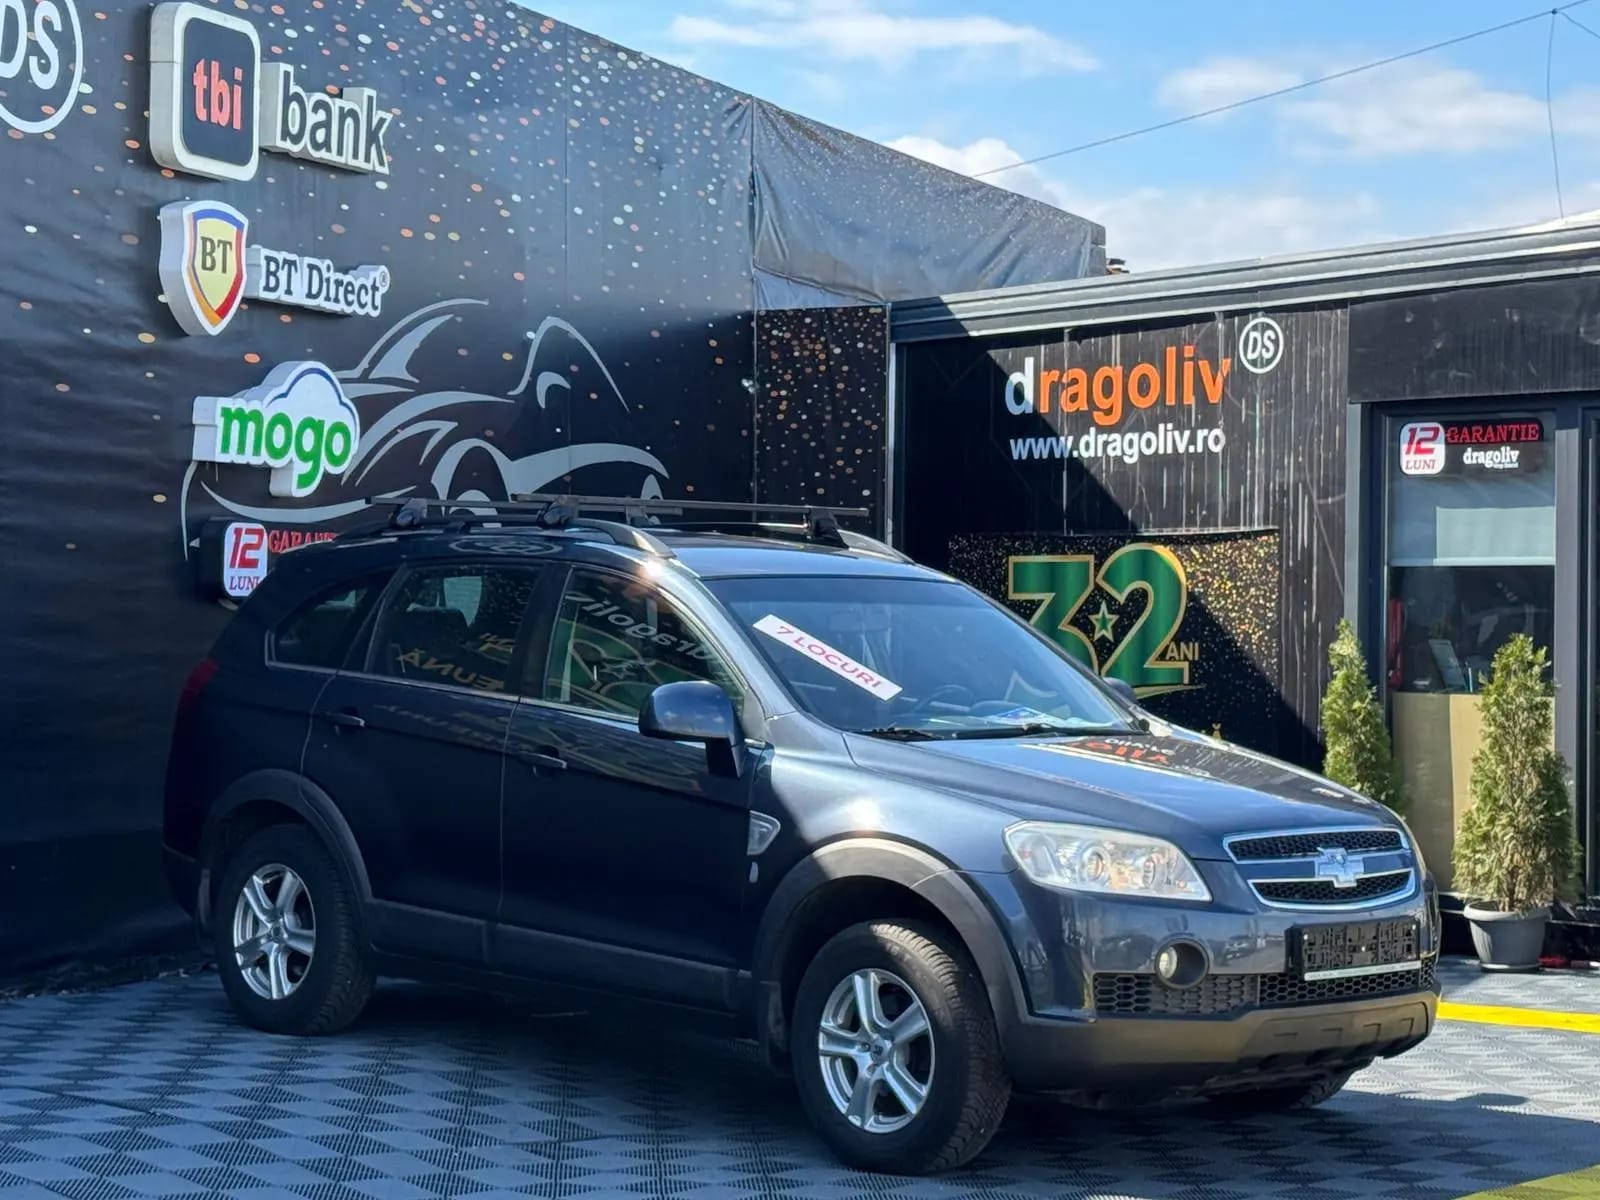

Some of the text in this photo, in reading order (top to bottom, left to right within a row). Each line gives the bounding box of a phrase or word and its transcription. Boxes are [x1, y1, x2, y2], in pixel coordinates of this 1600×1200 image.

[0, 0, 62, 90] DS
[193, 58, 243, 130] tbi
[281, 71, 387, 167] bank
[200, 236, 232, 274] BT
[262, 255, 299, 296] BT
[1246, 329, 1276, 360] DS
[1005, 345, 1232, 426] dragoliv
[220, 405, 352, 490] mogo
[1010, 423, 1226, 465] www.dragoliv.ro
[1404, 423, 1540, 455] 12 GARANTIE
[1463, 446, 1519, 468] dragoliv
[1405, 459, 1436, 471] LUNI
[229, 527, 265, 569] 12
[1008, 542, 1190, 685] 32
[776, 625, 882, 689] 7 LOCURI
[1165, 642, 1200, 661] ANI
